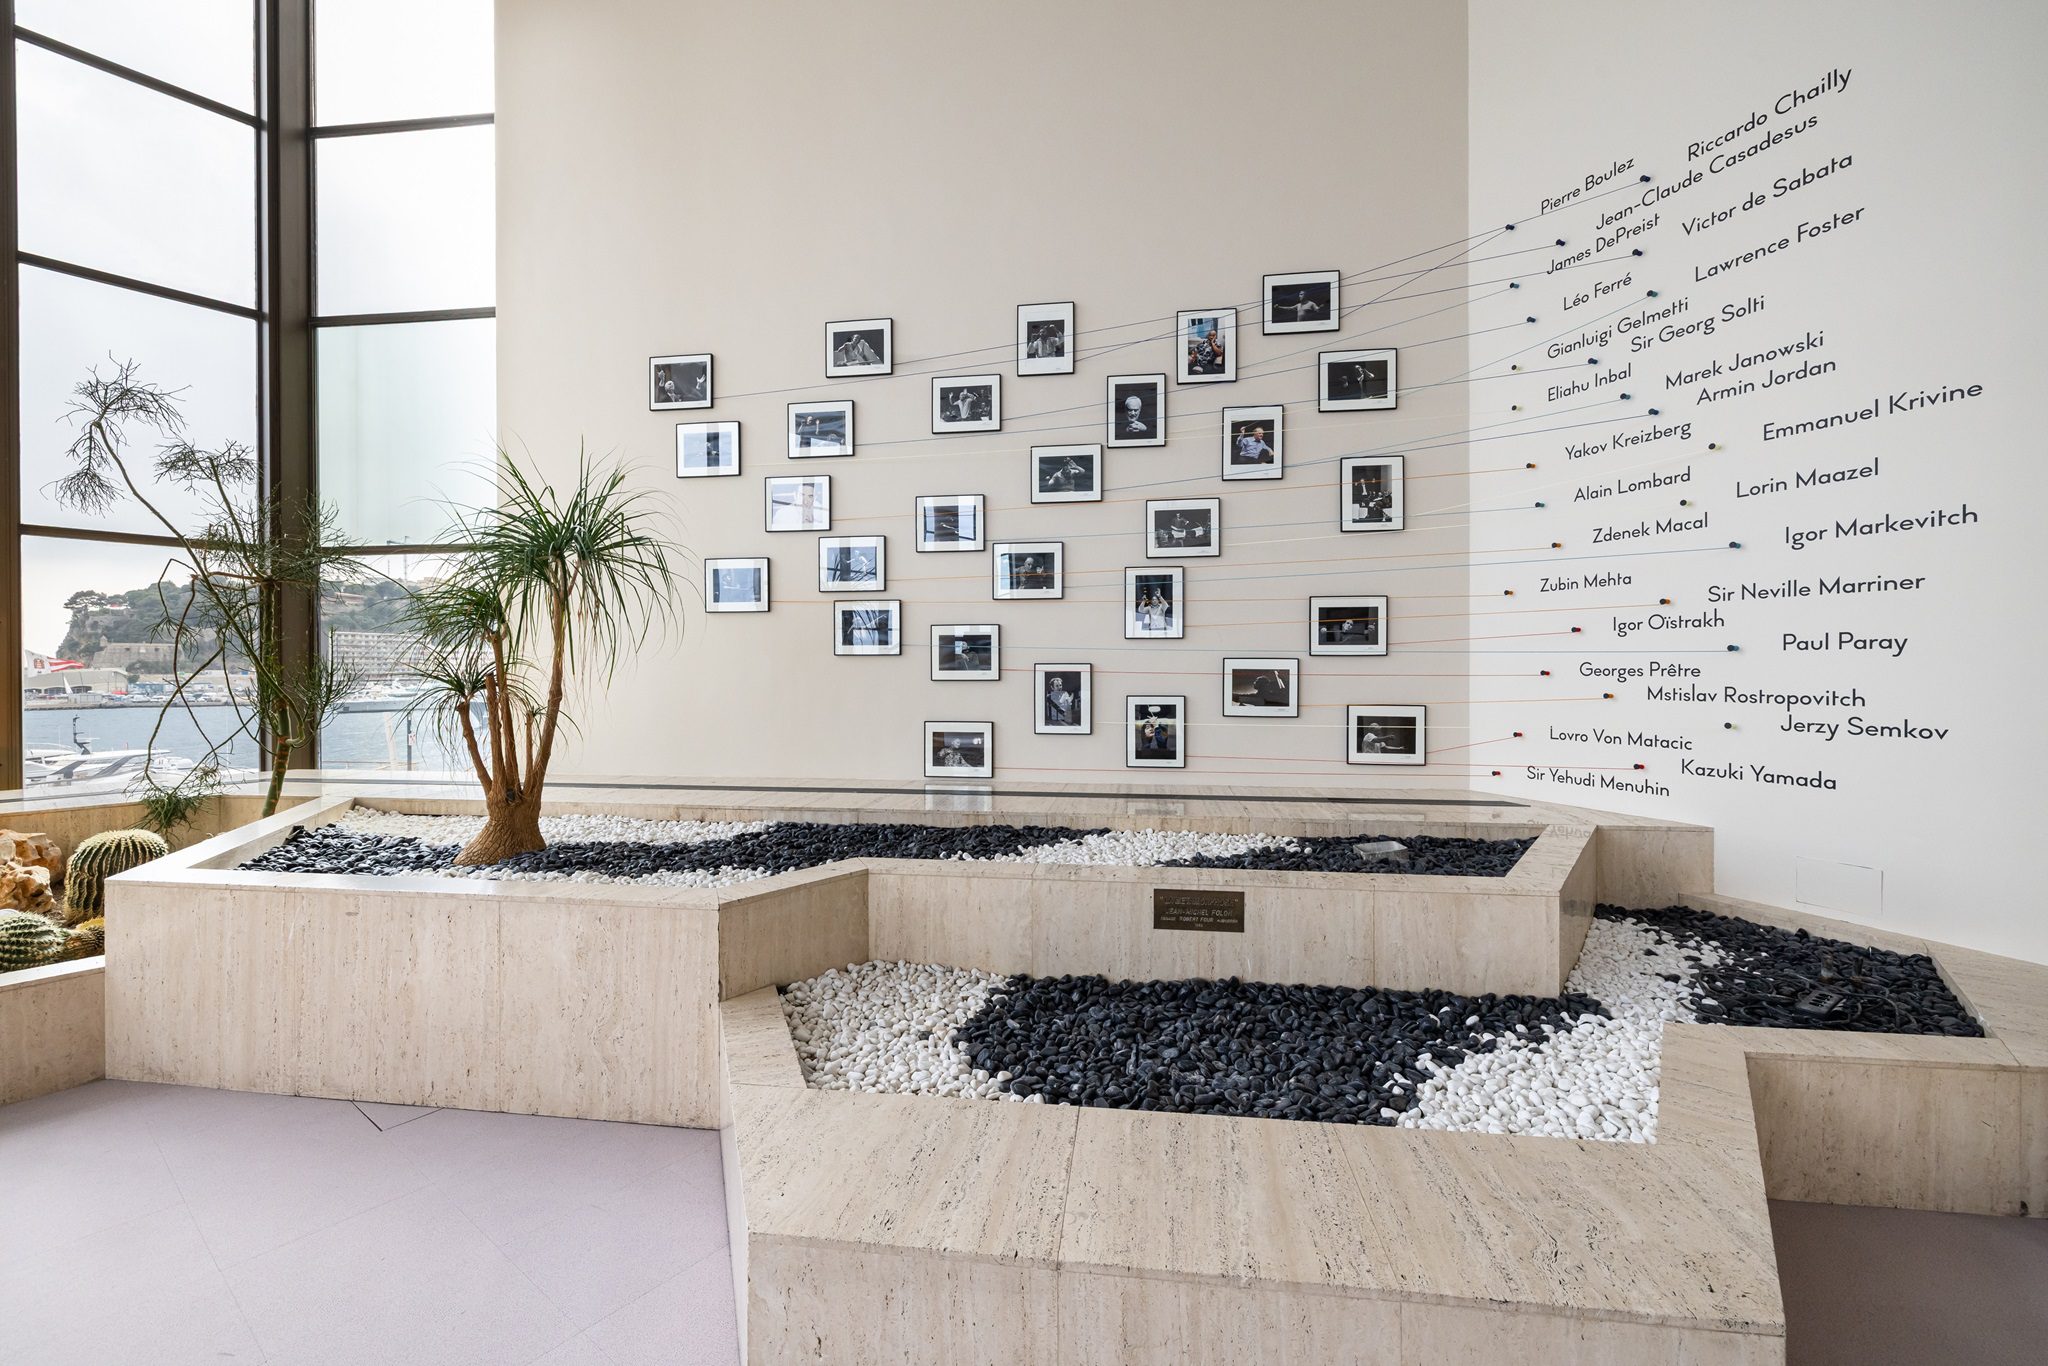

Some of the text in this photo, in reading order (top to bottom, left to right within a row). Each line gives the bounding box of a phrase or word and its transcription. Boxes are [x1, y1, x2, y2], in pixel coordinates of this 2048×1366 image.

[1687, 68, 1852, 161] Riccardo Chailly
[1539, 157, 1635, 217] Pierre Boulez
[1594, 114, 1818, 231] Jean-Claude Casadesus
[1681, 154, 1853, 237] Victor de Sabata
[1545, 212, 1661, 275] James DePreist
[1695, 207, 1865, 283] Lawrence Foster
[1563, 271, 1632, 312] Léo Ferré
[1547, 296, 1689, 359] Gianluigi Gelmetti
[1630, 294, 1765, 353] Sir Georg Solti
[1665, 330, 1824, 390] Marek Janowski
[1547, 361, 1632, 403] Eliahu Inbal
[1696, 360, 1836, 406] Armin Jordan
[1763, 384, 1984, 442] Emmanuel Krivine
[1564, 422, 1692, 461] Yakov Kreizberg
[1573, 465, 1691, 503] Alain Lombard
[1736, 456, 1879, 499] Lorin Maazel
[1592, 511, 1708, 544] Zdenek Macal
[1785, 503, 1978, 551] Igor Markevitch
[1539, 571, 1632, 593] Zubin Mehta
[1707, 574, 1926, 603] Sir Neville Marriner
[1613, 607, 1725, 638] Igor Oïstrakh
[1782, 631, 1909, 658] Paul Paray
[1579, 661, 1702, 684] Georges Prêtre
[1647, 682, 1866, 713] Mstislav Rostropovitch
[1549, 725, 1693, 751] Lovro Von Matacic
[1780, 713, 1949, 742] Jerzy Semkov
[1527, 765, 1670, 797] Sir Yehudi Menuhin
[1681, 758, 1837, 791] Kazuki Yamada
